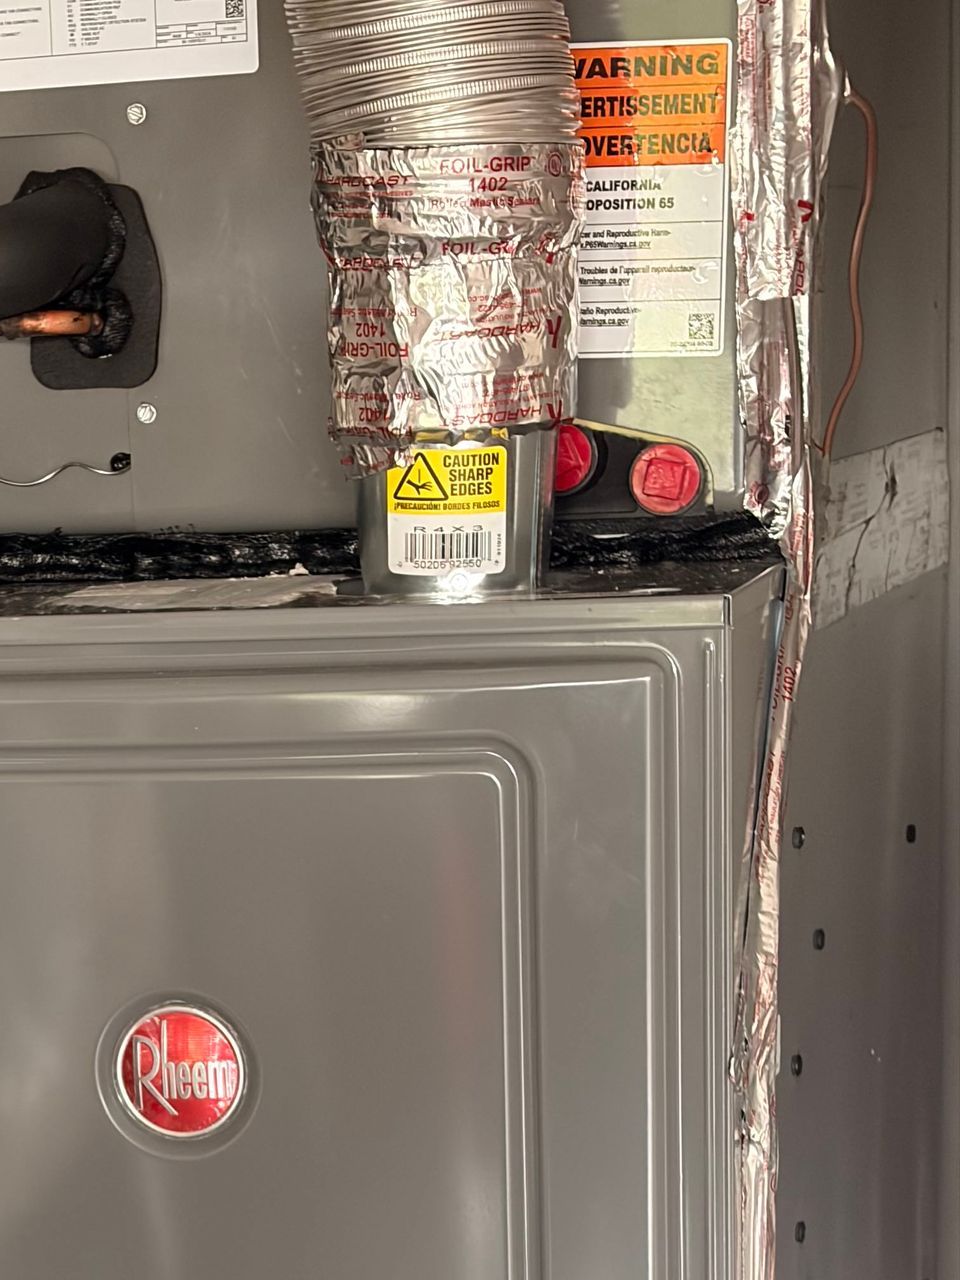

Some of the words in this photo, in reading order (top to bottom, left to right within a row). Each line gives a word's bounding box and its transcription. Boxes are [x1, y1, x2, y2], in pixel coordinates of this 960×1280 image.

[581, 93, 718, 118] ERTISSEMENT
[469, 177, 507, 192] 1402
[586, 198, 655, 210] OPOSITION
[659, 197, 674, 209] 65
[593, 230, 604, 238] and
[606, 229, 649, 240] Reproductive
[356, 323, 385, 337] 1402
[359, 407, 389, 421] 1402
[443, 453, 499, 468] CAUTION
[449, 468, 493, 482] SHARP
[451, 482, 492, 496] EDGES
[443, 502, 470, 510] BORDES
[473, 501, 500, 509] FILOSOS
[781, 666, 797, 702] 1402
[132, 1019, 237, 1116] Rheem
